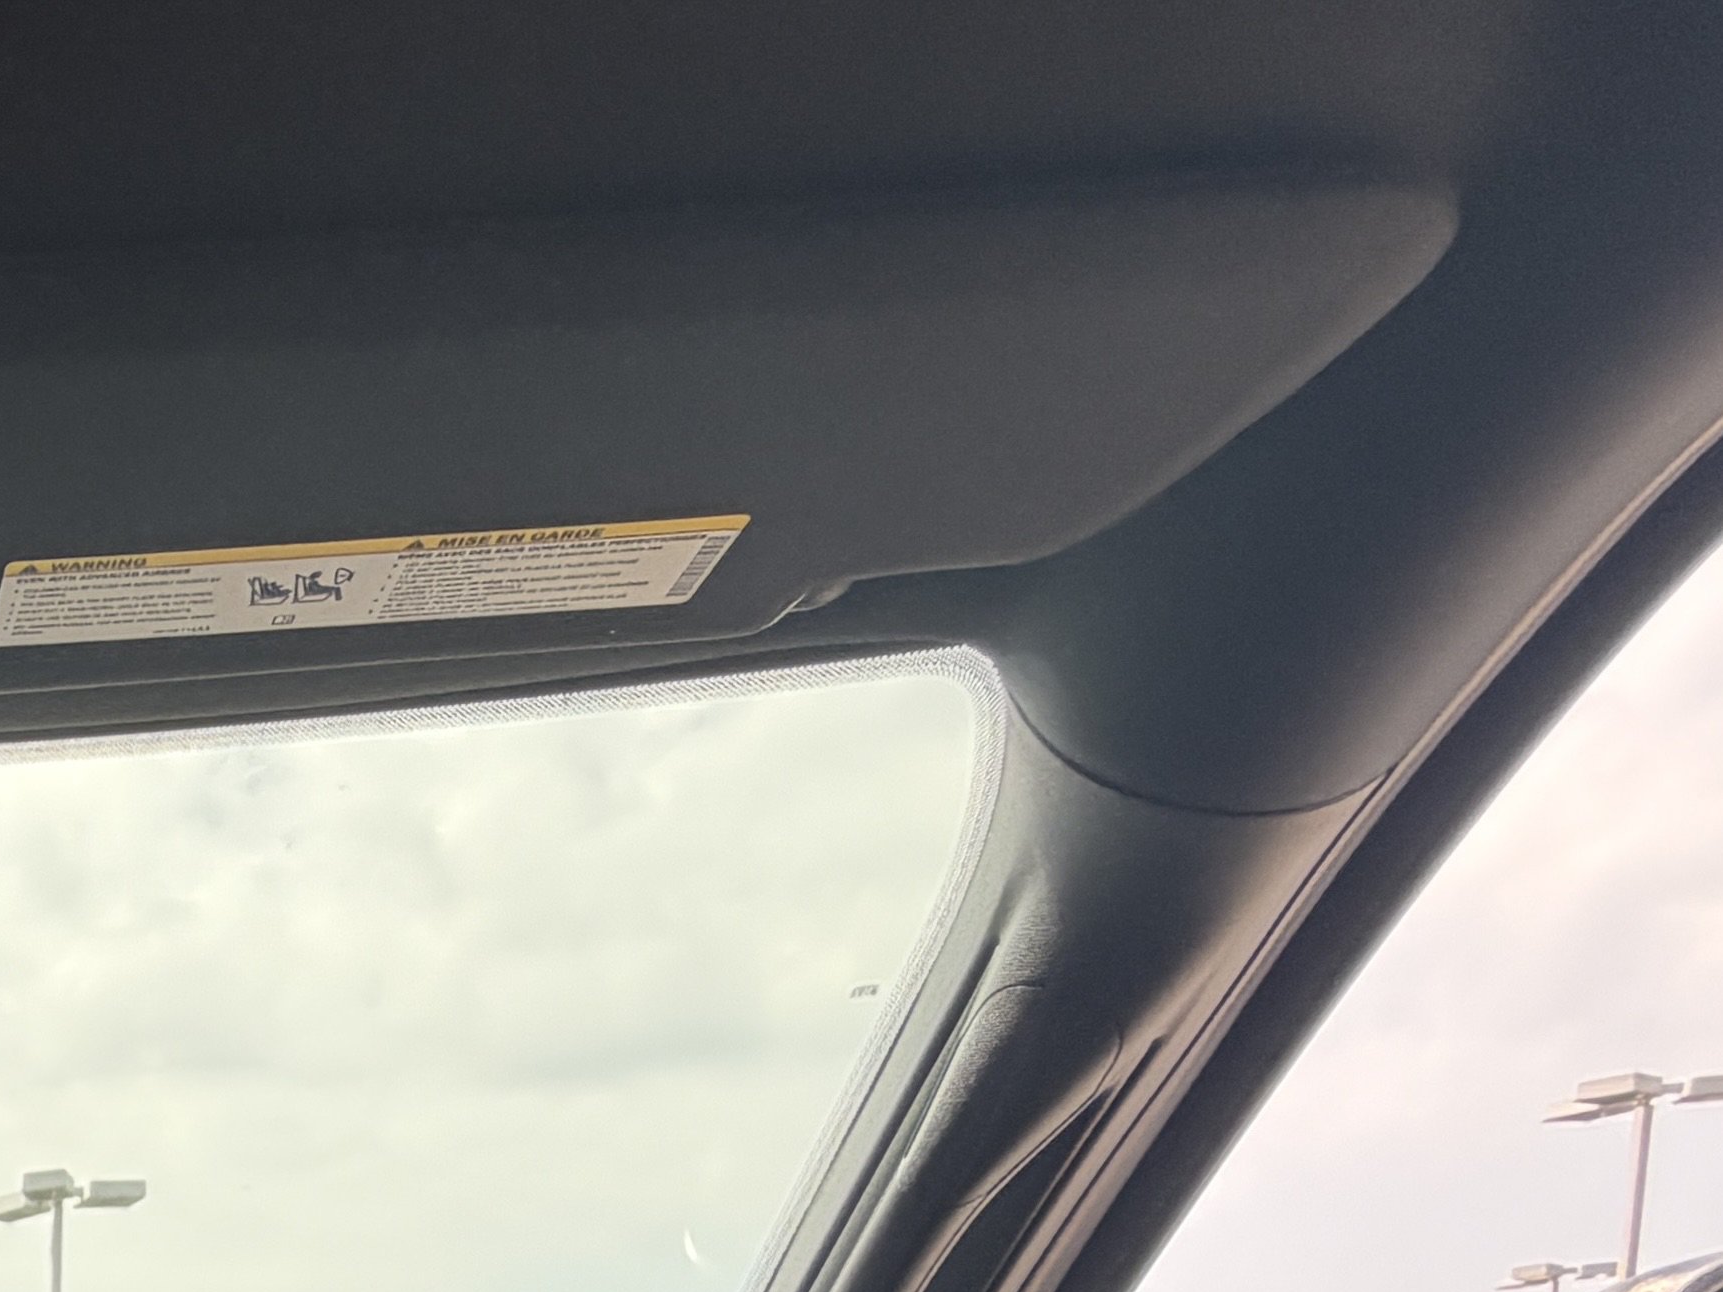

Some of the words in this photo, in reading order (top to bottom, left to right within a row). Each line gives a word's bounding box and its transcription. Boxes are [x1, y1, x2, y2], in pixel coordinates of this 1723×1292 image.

[437, 534, 492, 548] MISE
[494, 532, 526, 545] EN
[530, 527, 606, 542] GARDE
[50, 557, 149, 573] WARNING
